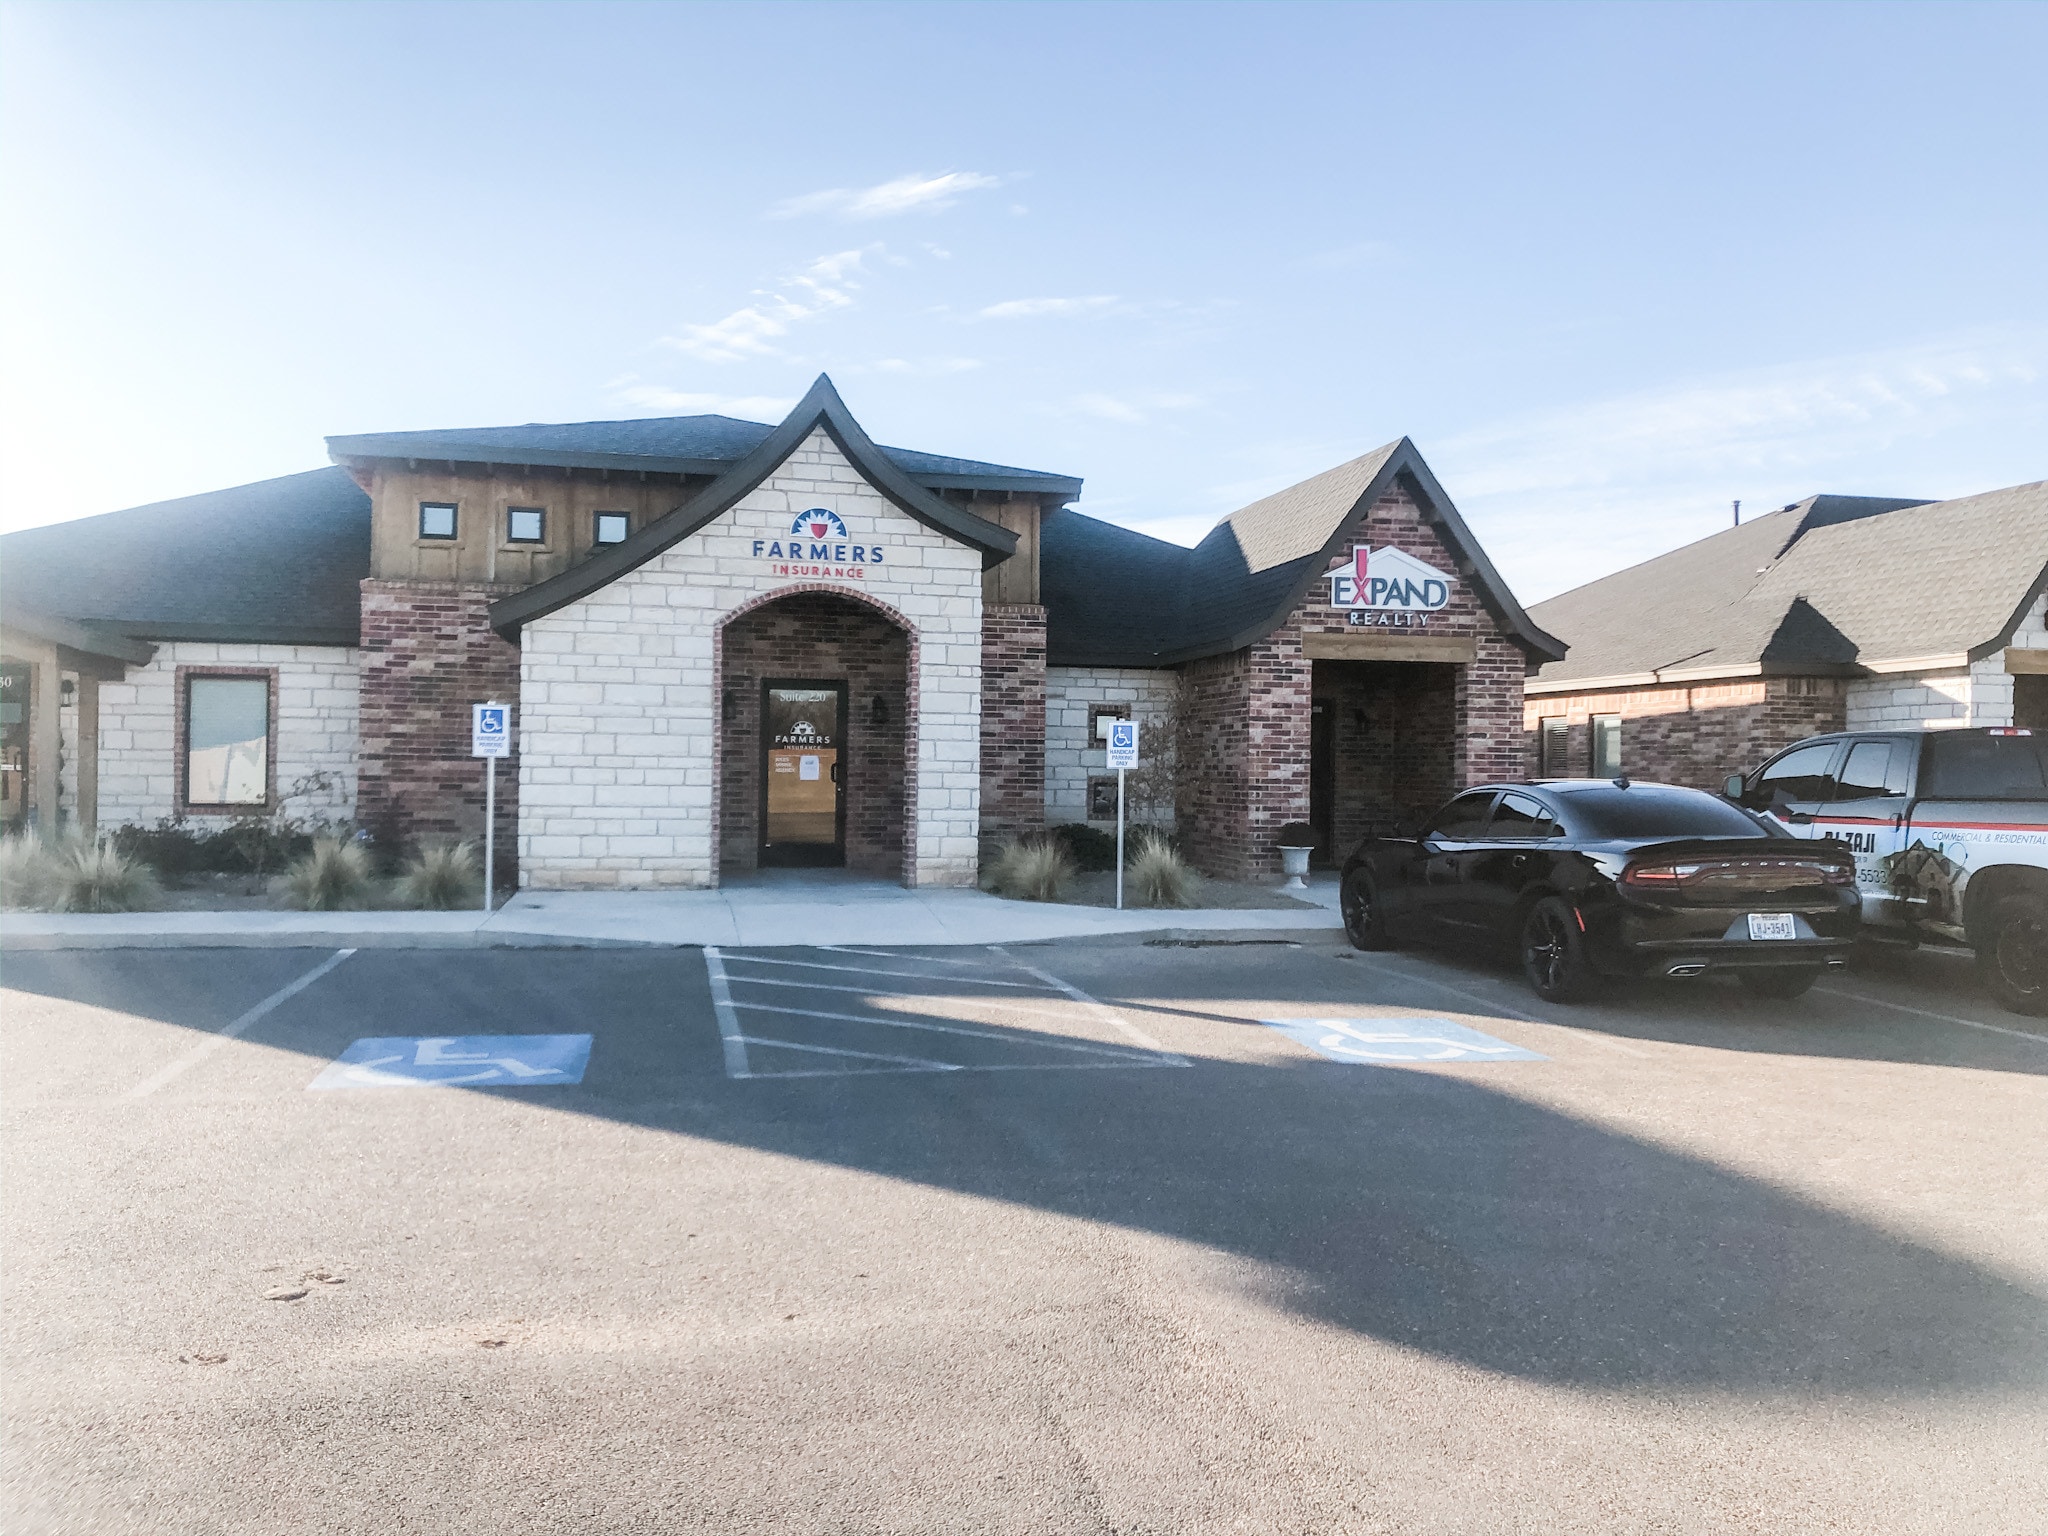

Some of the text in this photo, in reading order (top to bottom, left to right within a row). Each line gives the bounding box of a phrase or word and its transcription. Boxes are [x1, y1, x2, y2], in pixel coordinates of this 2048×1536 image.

[752, 540, 884, 563] FARMERS
[772, 564, 864, 579] INSURANCE
[1334, 576, 1447, 607] EXPAND
[1350, 611, 1429, 626] REALTY
[780, 691, 826, 702] Suite 220
[775, 735, 831, 744] FARMERS
[1932, 831, 2047, 845] COMMERCIAL & RESIDENTIAL
